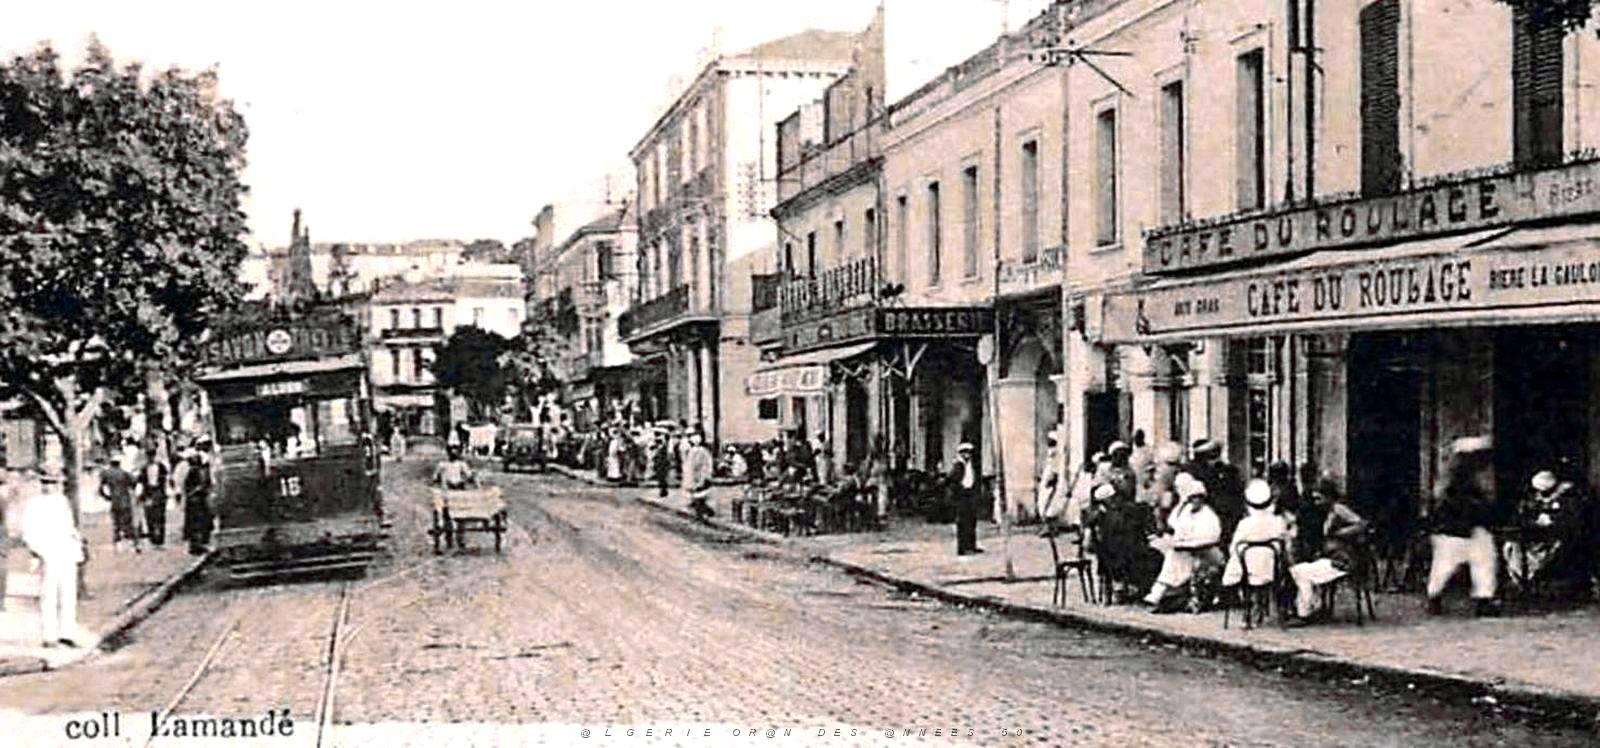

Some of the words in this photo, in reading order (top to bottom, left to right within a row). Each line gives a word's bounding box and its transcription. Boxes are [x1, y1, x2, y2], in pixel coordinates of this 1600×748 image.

[1160, 228, 1234, 268] CAFE
[1254, 217, 1292, 251] DU
[1316, 181, 1500, 239] ROULAGE
[1247, 277, 1300, 318] CAFE
[1313, 273, 1343, 312] DU
[1359, 261, 1472, 309] ROULAGE
[1531, 264, 1548, 287] LA
[208, 331, 265, 361] SAVON
